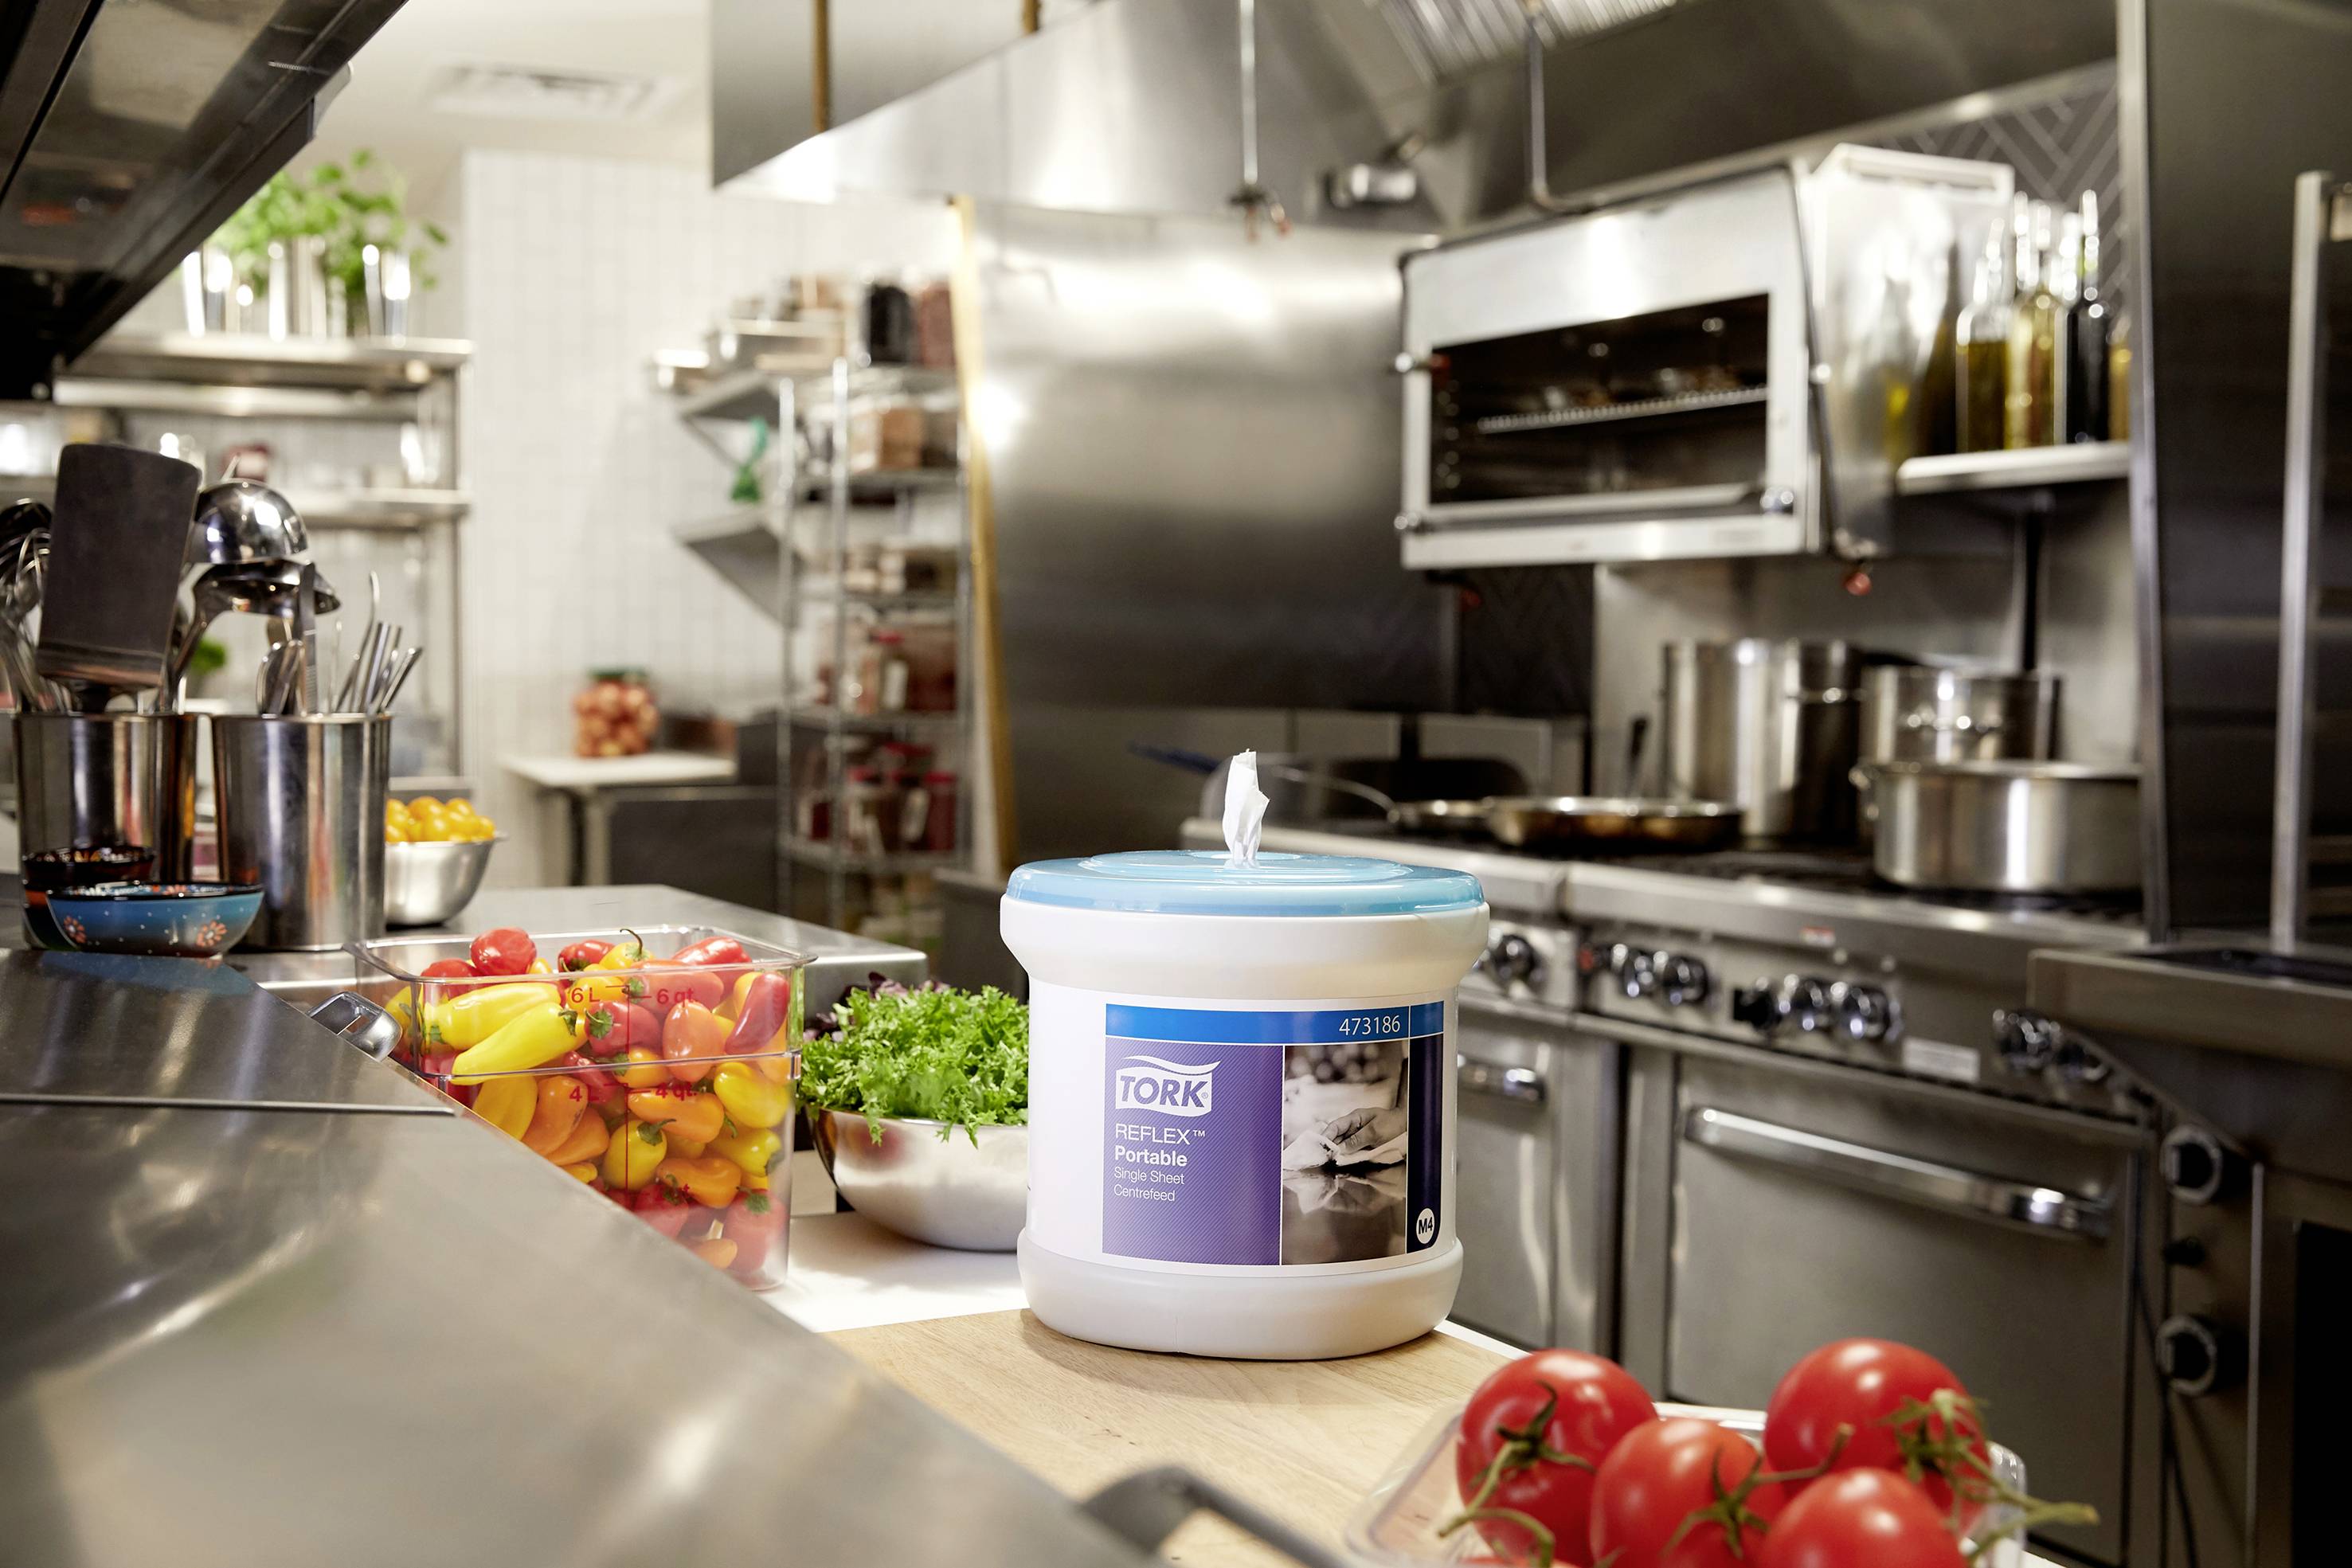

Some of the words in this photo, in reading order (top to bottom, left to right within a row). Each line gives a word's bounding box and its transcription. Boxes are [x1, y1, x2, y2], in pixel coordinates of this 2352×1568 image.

[570, 987, 584, 1003] 6
[589, 987, 601, 1003] L
[656, 988, 669, 1005] 6
[1339, 1015, 1401, 1036] 473186
[569, 1085, 583, 1102] 4
[587, 1085, 600, 1102] L
[655, 1081, 668, 1099] 4
[1115, 1144, 1188, 1167] Portable
[1113, 1166, 1148, 1183] Single
[1150, 1170, 1185, 1185] Sheet
[1113, 1183, 1176, 1202] Centrefeed
[1418, 1216, 1433, 1235] M4
